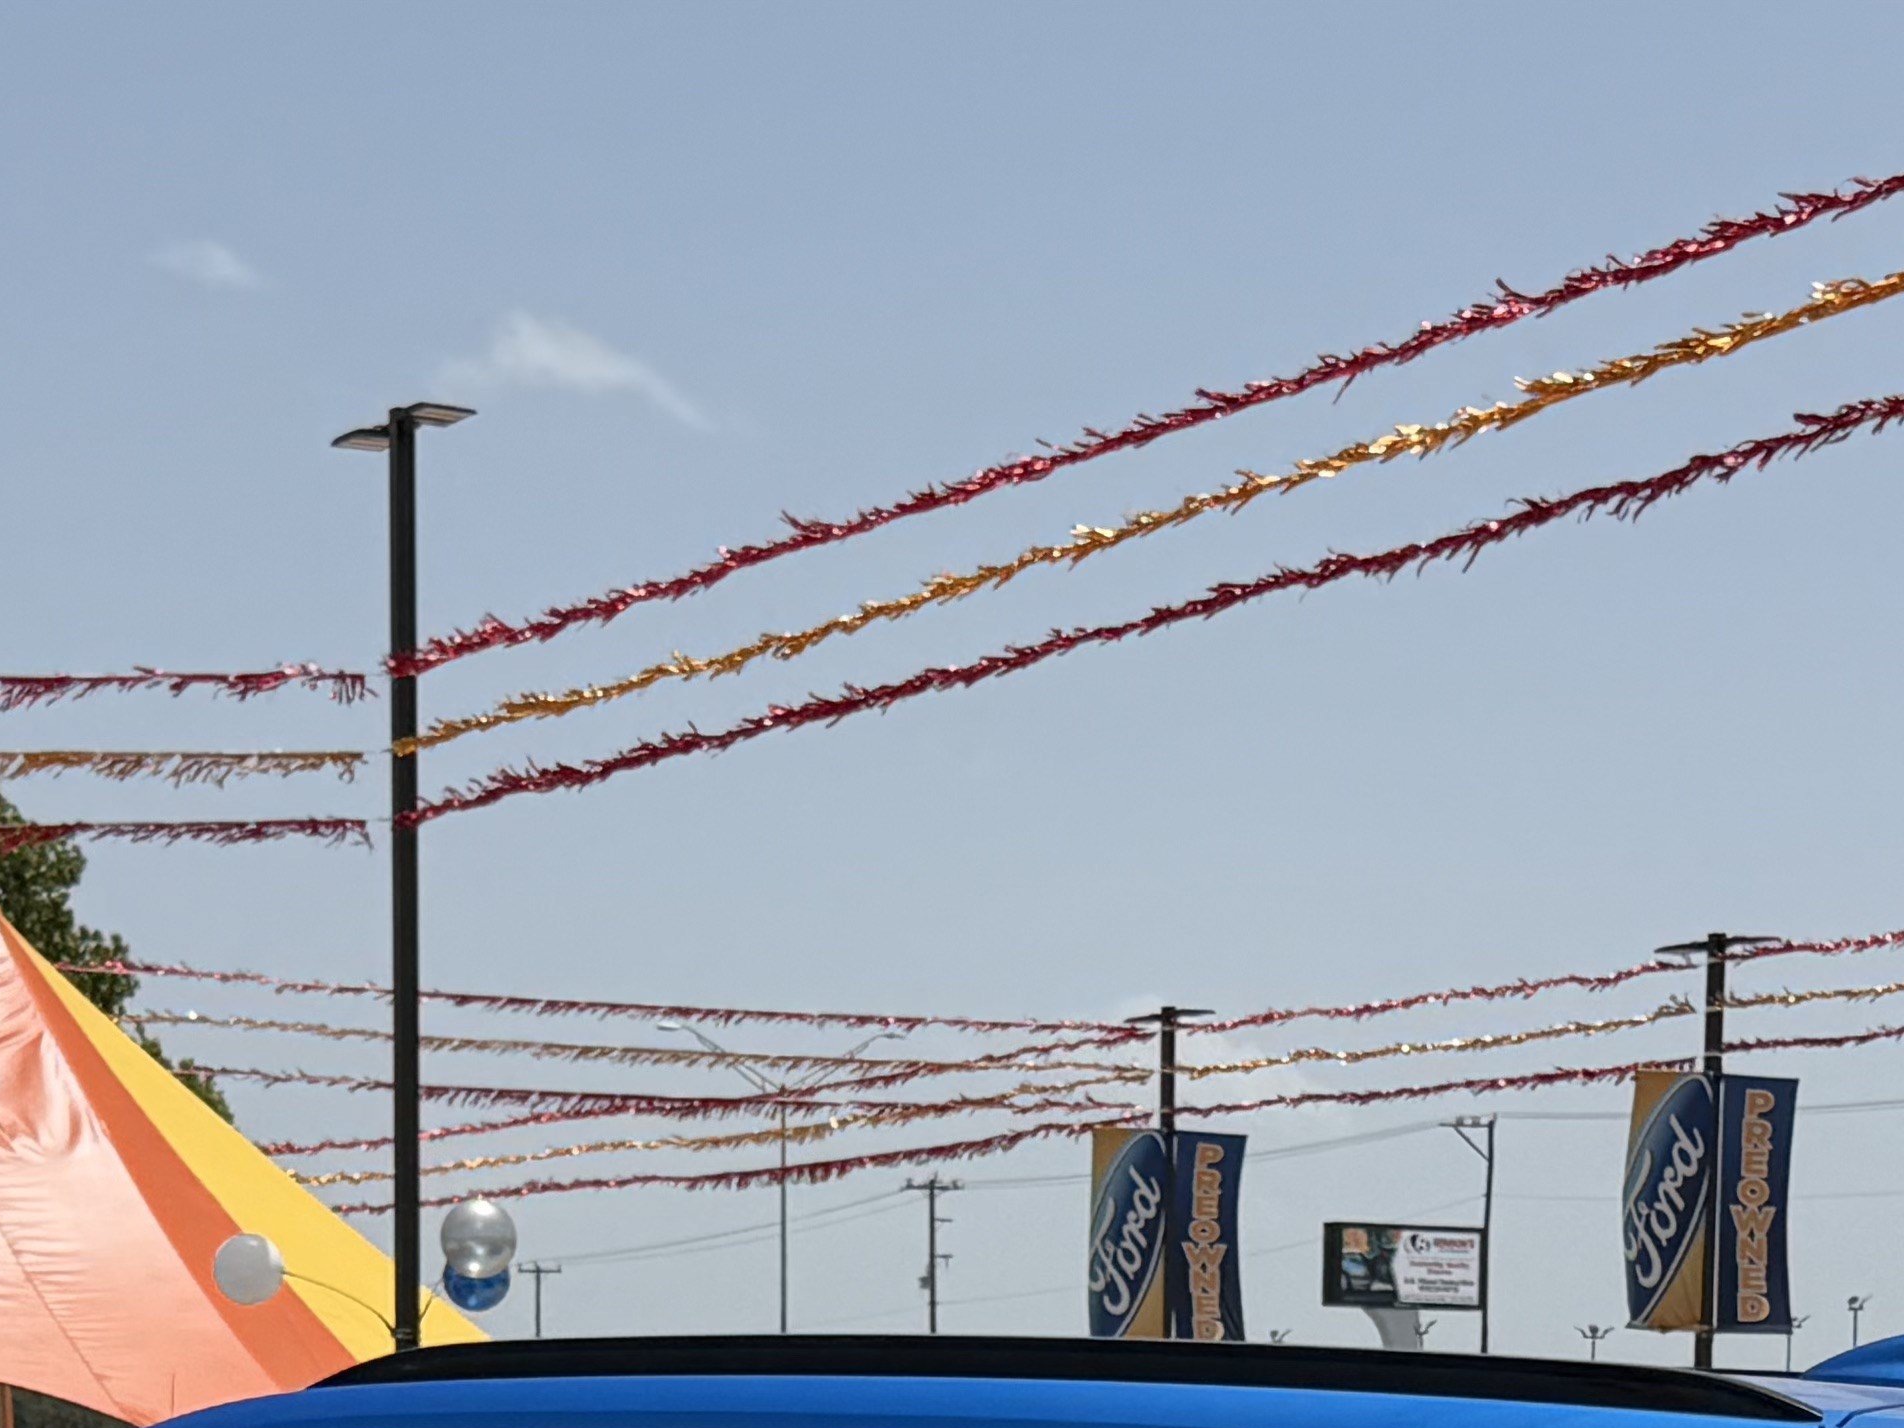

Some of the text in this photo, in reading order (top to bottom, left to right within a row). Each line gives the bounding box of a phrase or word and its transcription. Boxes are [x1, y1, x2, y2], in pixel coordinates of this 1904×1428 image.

[1089, 1164, 1162, 1316] Ford
[1624, 1113, 1706, 1289] Ford
[1729, 1088, 1777, 1323] PREOWNED
